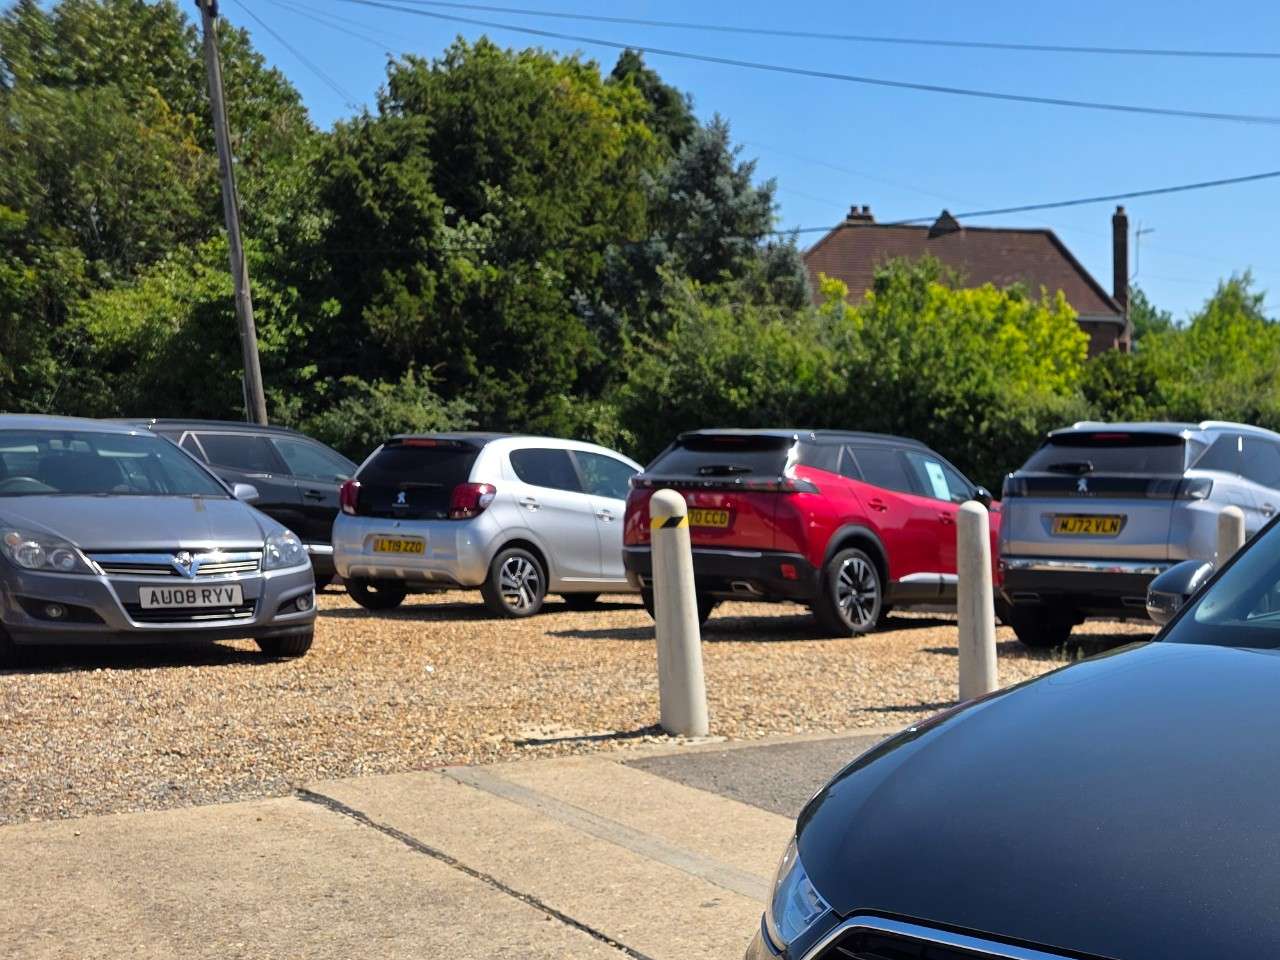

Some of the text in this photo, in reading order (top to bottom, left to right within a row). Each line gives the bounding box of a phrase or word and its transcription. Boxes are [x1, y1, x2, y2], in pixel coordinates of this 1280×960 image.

[1095, 519, 1119, 533] VLN
[150, 588, 234, 605] AU08 RYV
